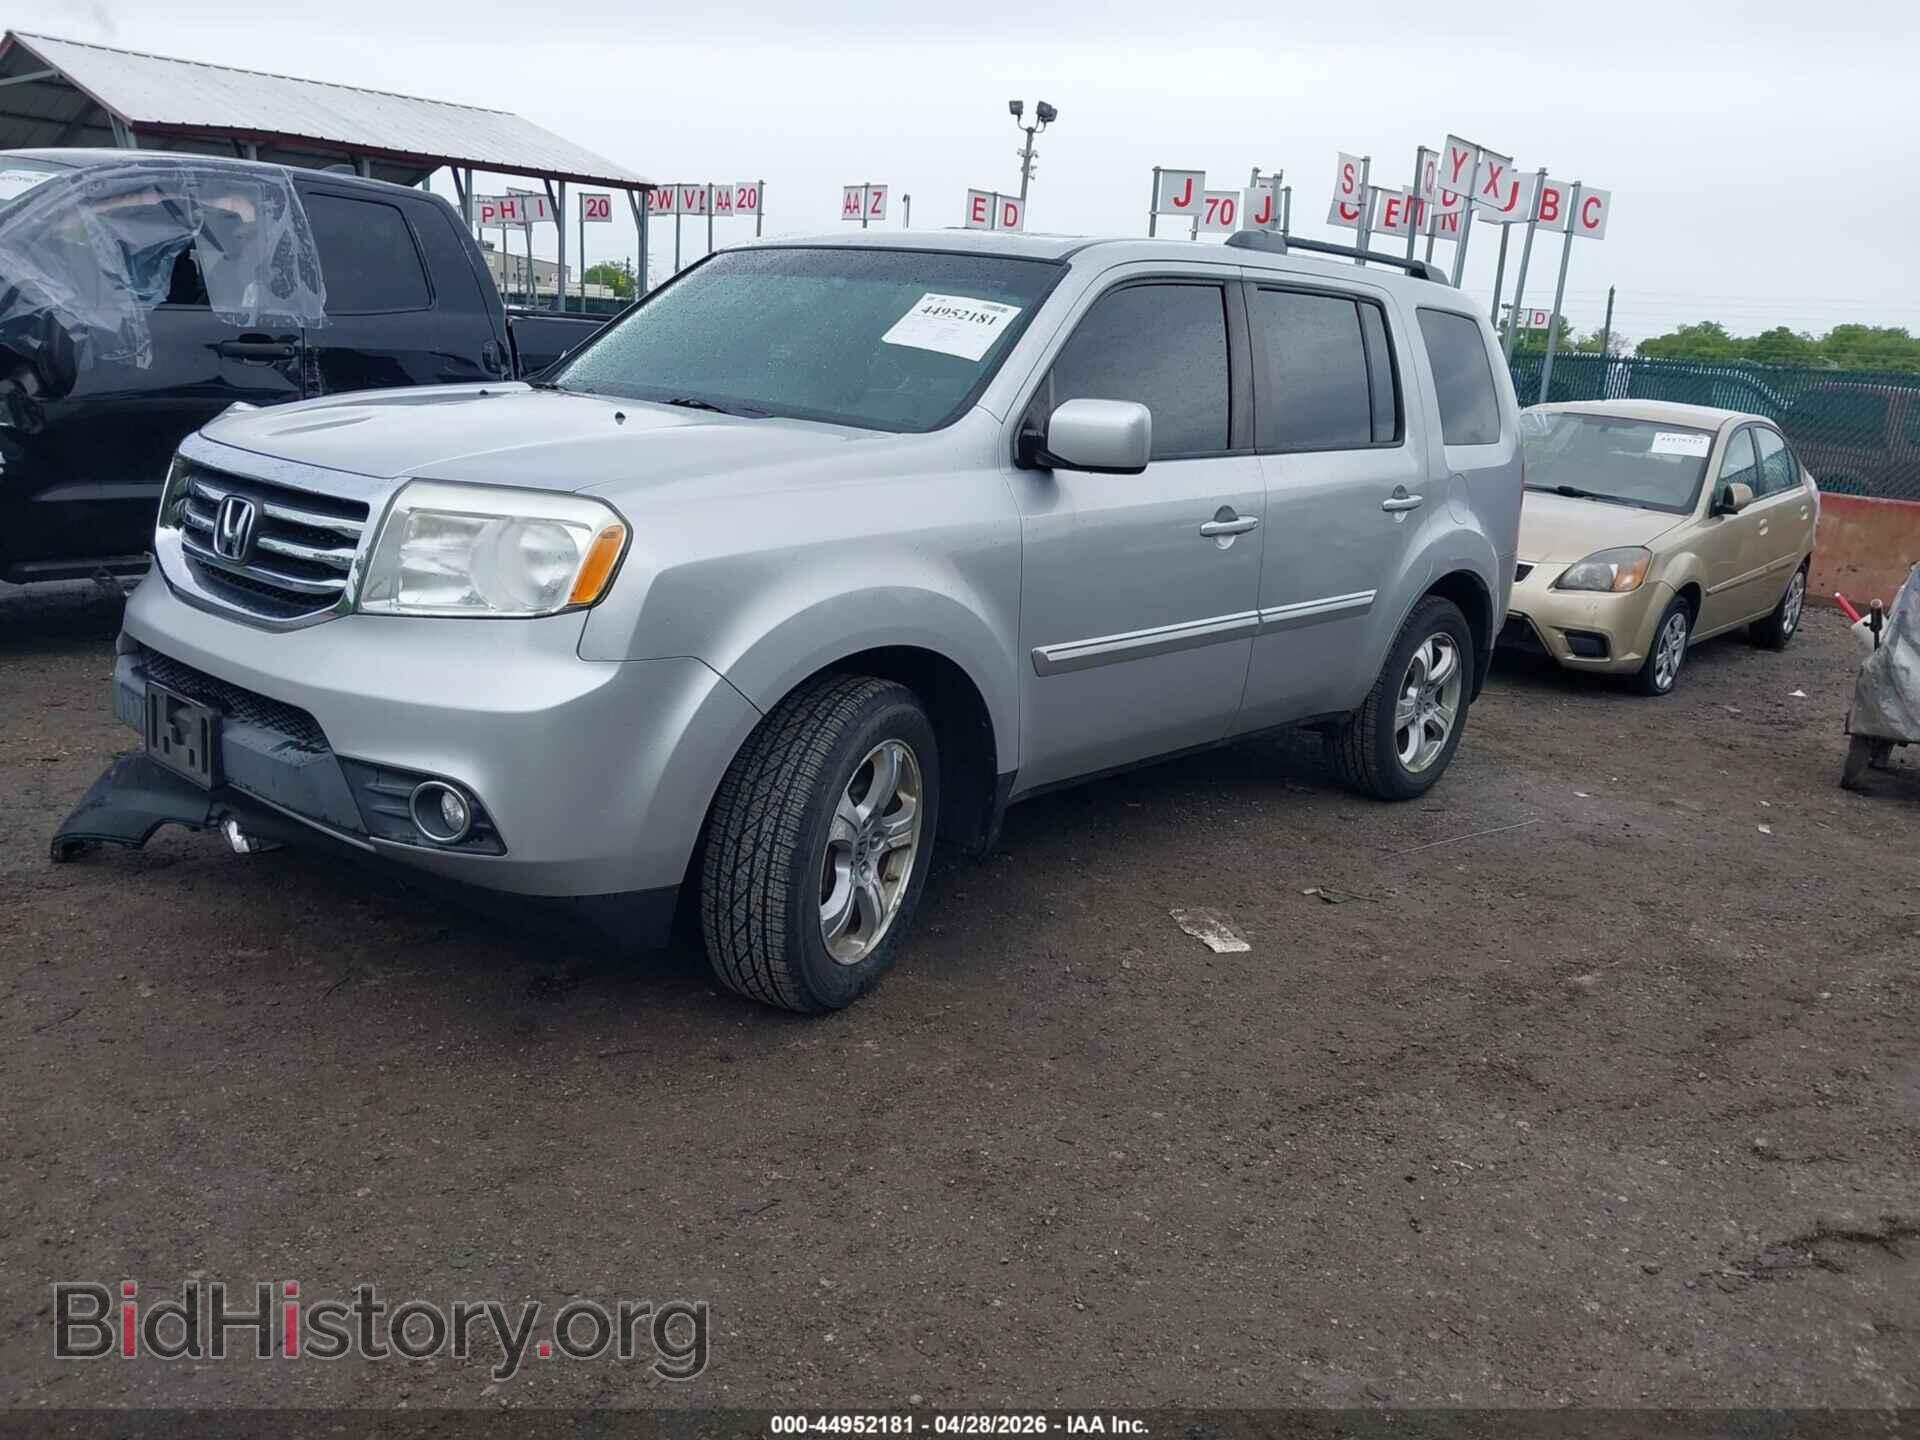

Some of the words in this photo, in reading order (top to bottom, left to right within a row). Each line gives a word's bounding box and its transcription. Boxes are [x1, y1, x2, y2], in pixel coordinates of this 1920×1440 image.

[1452, 147, 1469, 183] Y
[1342, 163, 1354, 194] S
[1483, 161, 1503, 198] X
[657, 190, 673, 209] W
[684, 190, 695, 209] V
[716, 191, 731, 209] AA
[737, 188, 757, 209] 20
[844, 191, 860, 214] AA
[871, 192, 882, 214] Z
[1173, 178, 1192, 207] J
[1503, 181, 1520, 212] J
[482, 206, 494, 223] P
[500, 201, 515, 218] H
[538, 200, 544, 217] I
[587, 199, 609, 217] 20
[972, 198, 985, 222] E
[1004, 203, 1018, 228] D
[1205, 199, 1234, 225] 70
[1254, 195, 1271, 223] J
[1384, 198, 1400, 227] E
[1539, 188, 1560, 221] B
[1582, 197, 1603, 228] C
[921, 305, 997, 325] 44952181
[1535, 312, 1545, 325] D
